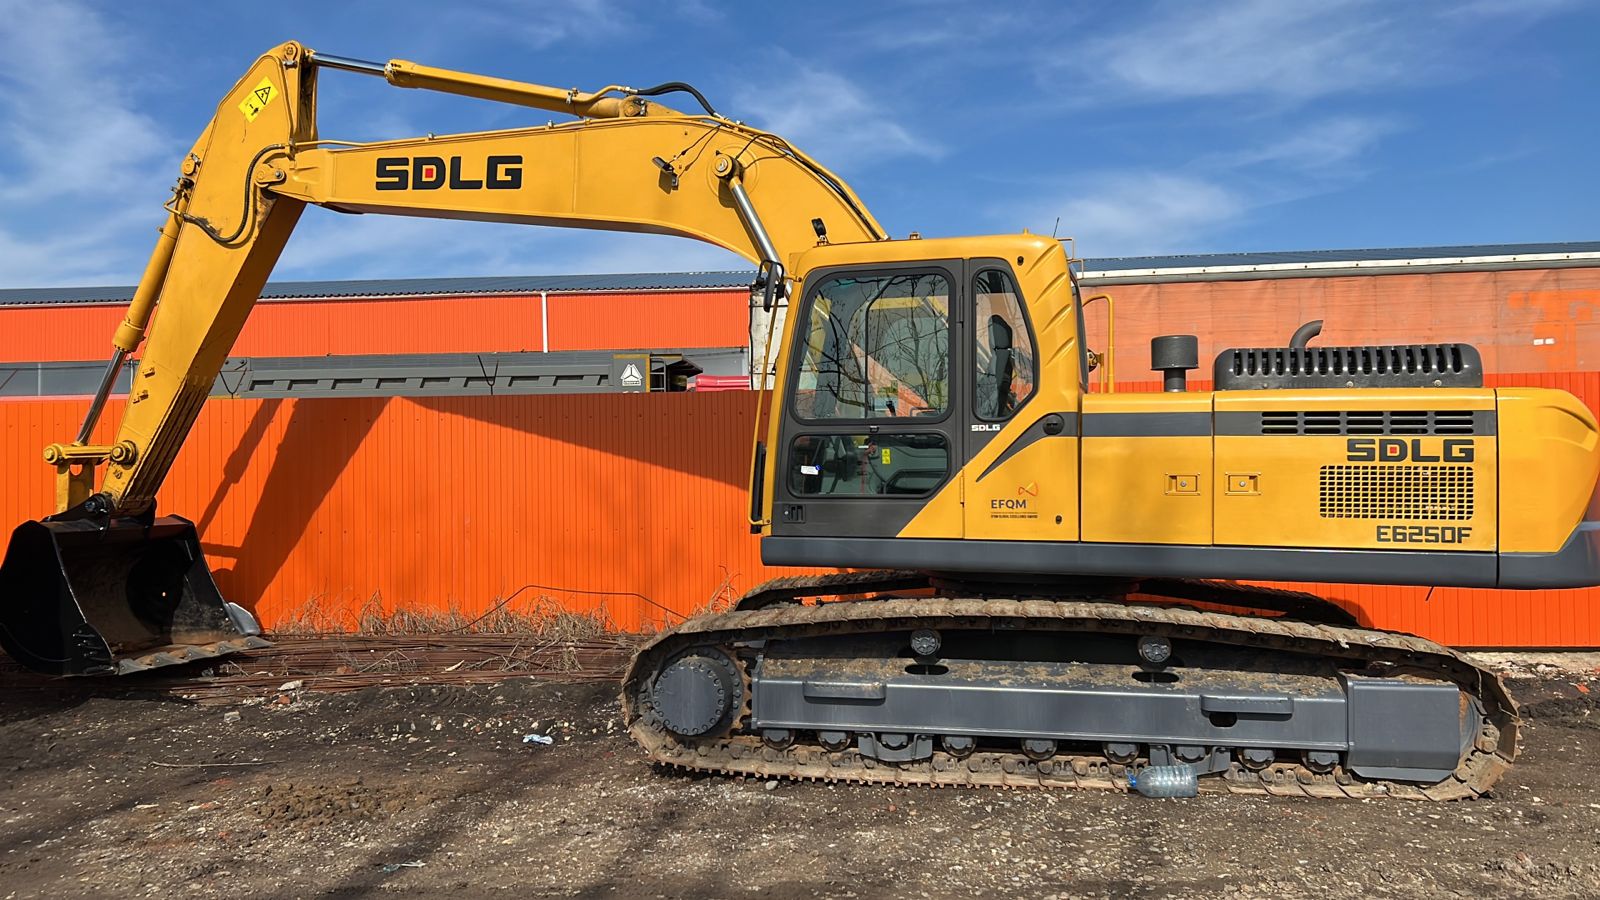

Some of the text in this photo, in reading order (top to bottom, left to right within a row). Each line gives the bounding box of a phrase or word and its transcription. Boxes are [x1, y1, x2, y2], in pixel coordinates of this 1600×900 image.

[376, 156, 523, 190] SDLG
[1347, 439, 1474, 462] SDLG
[991, 500, 1026, 509] EFQM
[1377, 526, 1472, 543] E6250F
